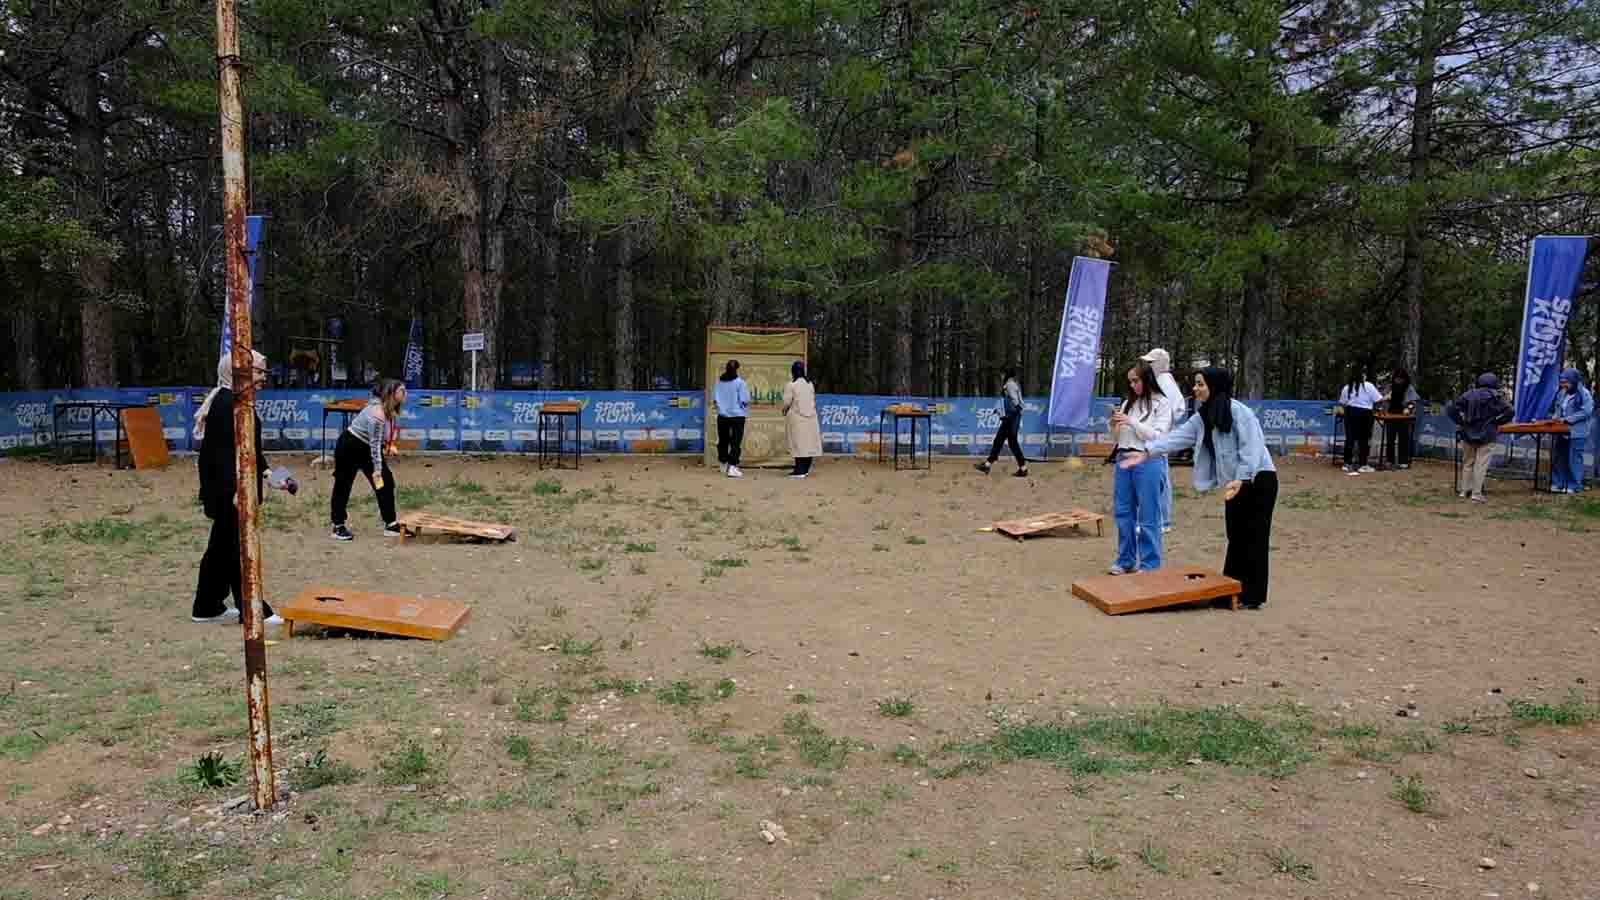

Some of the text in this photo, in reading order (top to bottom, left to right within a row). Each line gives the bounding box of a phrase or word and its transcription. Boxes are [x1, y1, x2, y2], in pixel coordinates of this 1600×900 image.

[1061, 305, 1083, 377] KONYA
[1081, 305, 1099, 363] SPOR
[1524, 297, 1552, 386] KONYA
[1543, 296, 1571, 366] SPOR
[256, 400, 297, 410] SPOR
